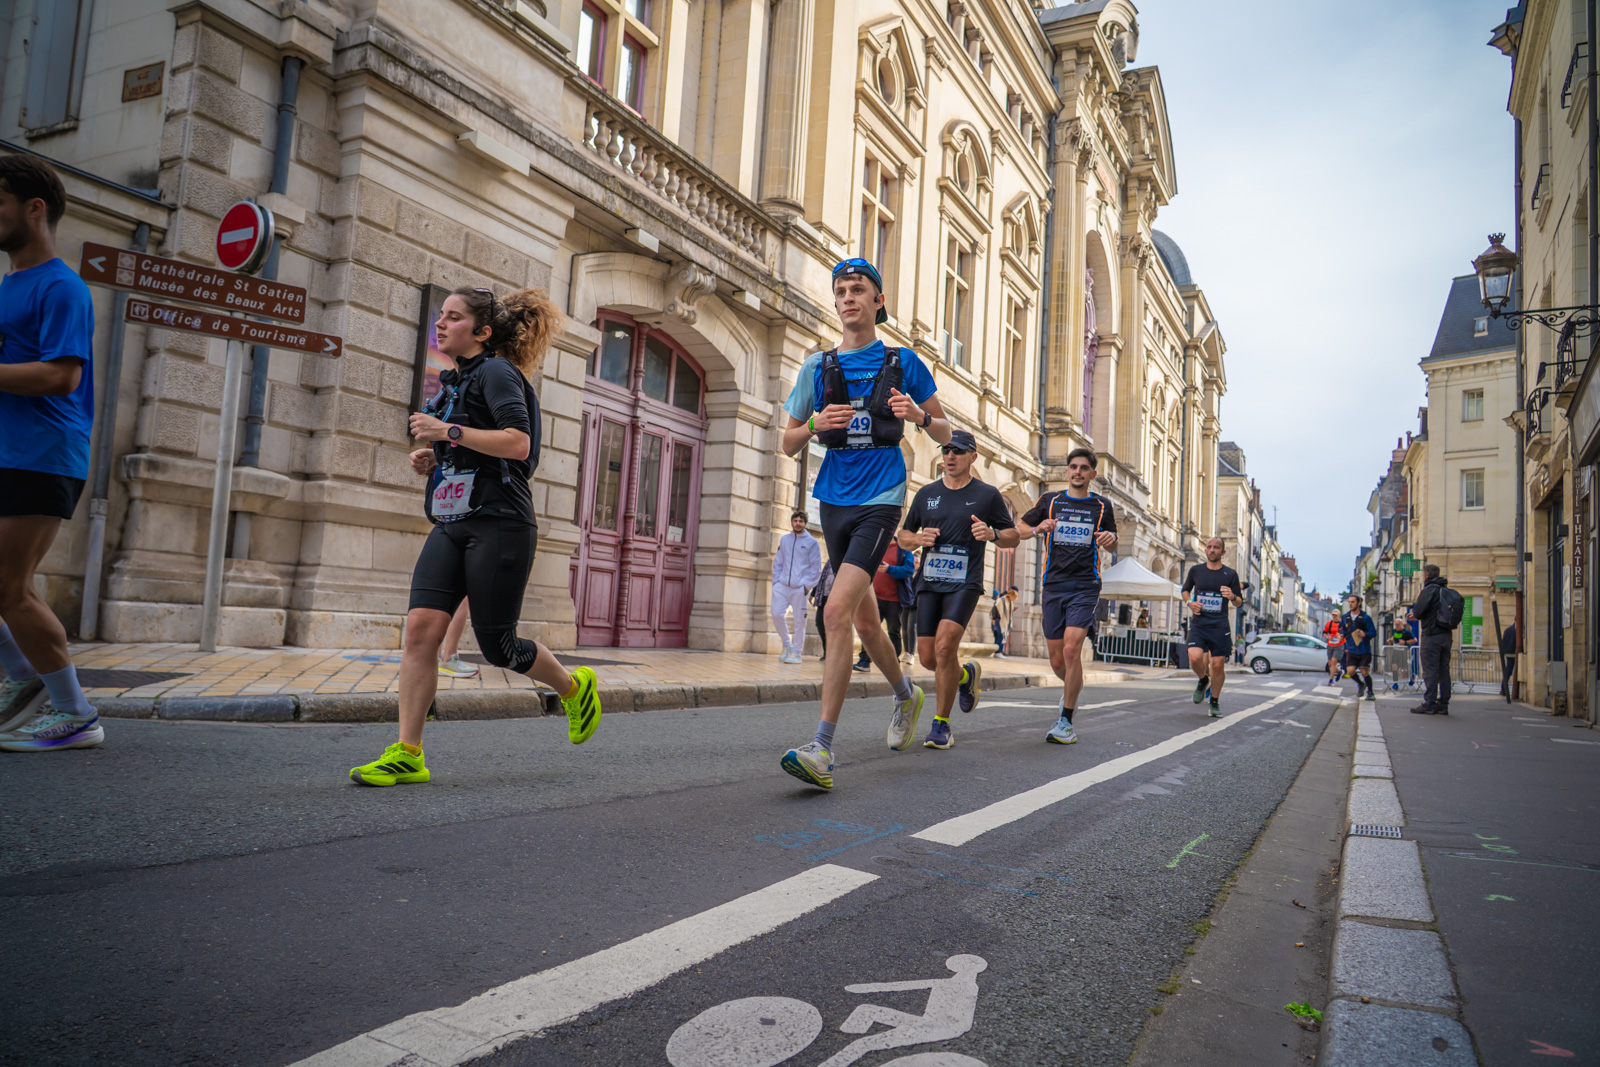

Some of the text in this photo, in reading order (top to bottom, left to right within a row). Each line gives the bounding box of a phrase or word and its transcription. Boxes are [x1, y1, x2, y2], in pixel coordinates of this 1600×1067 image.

[138, 274, 301, 317] Musée des Beaux Arts
[141, 259, 304, 303] Cathédrale St Gatien
[152, 308, 307, 345] Office de Tourisme
[845, 416, 871, 432] 49
[1057, 525, 1090, 537] 42830
[927, 558, 964, 571] 42784
[1574, 513, 1583, 587] THEATRE
